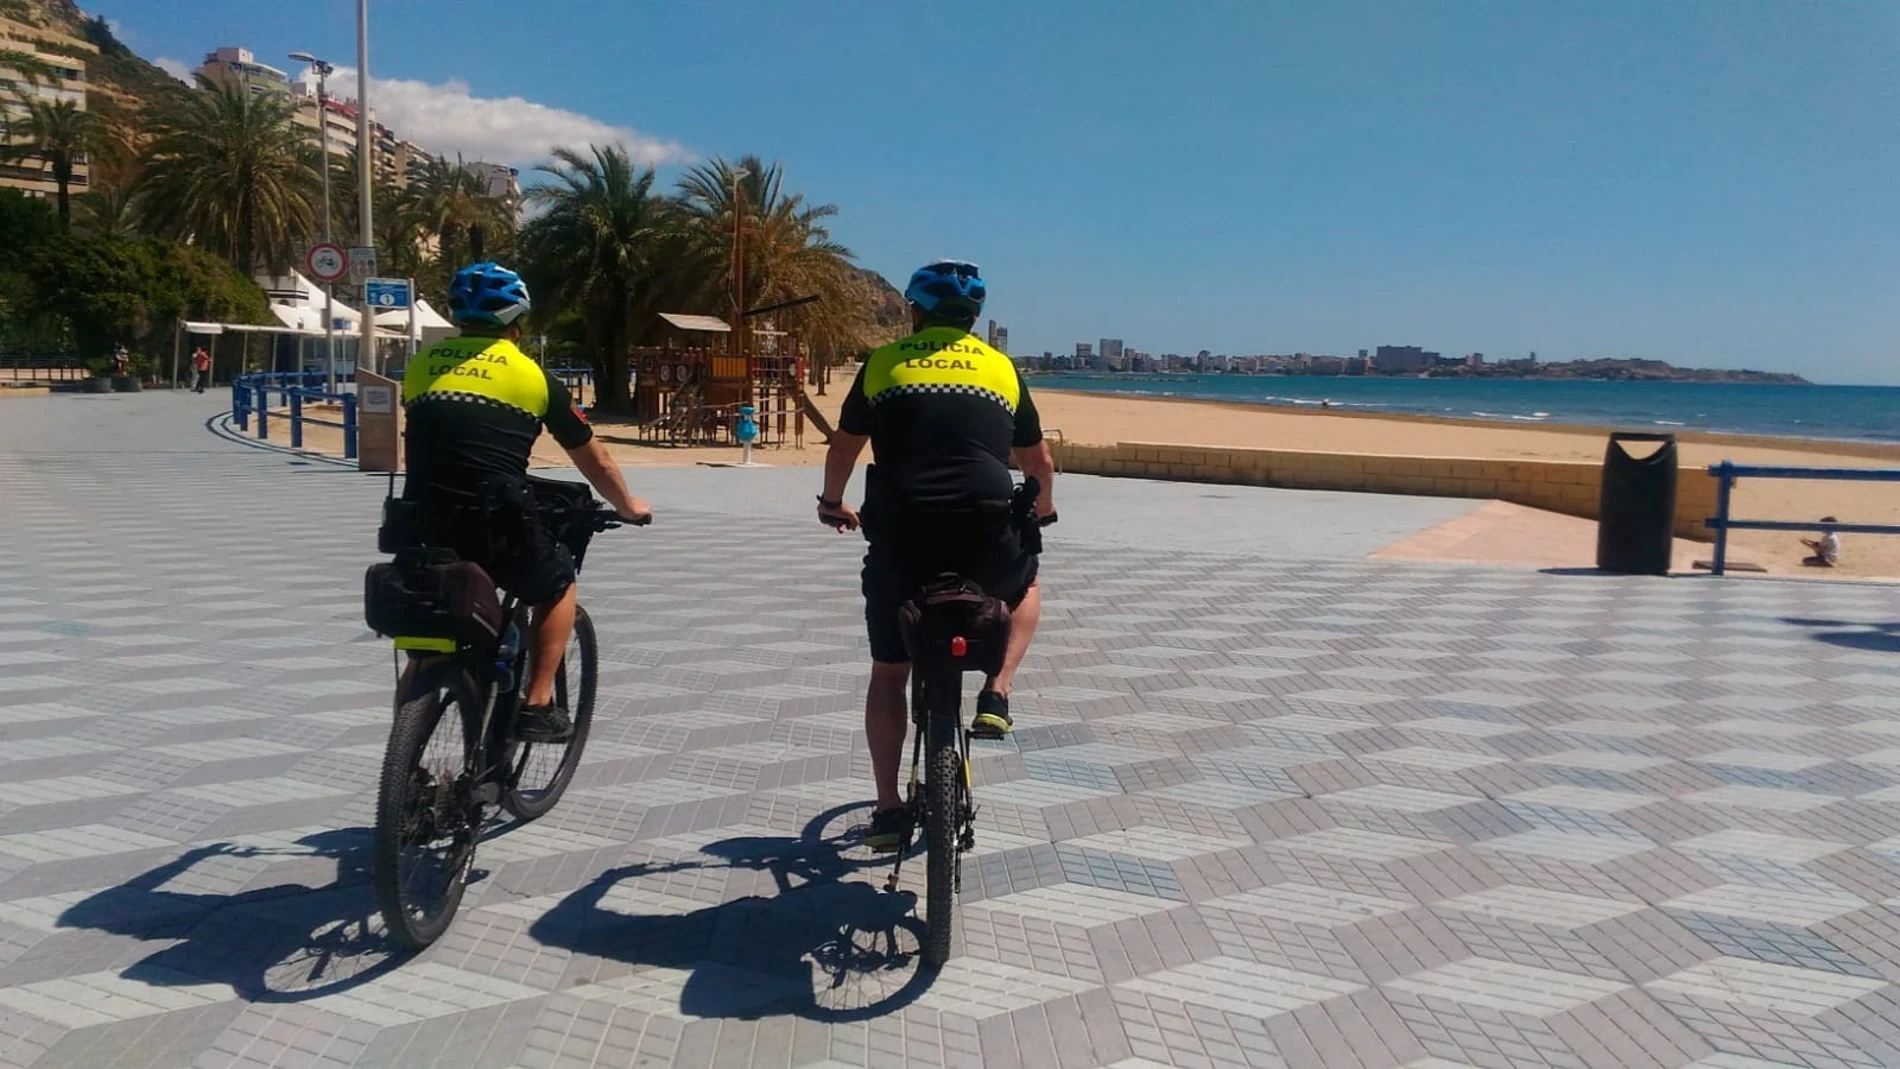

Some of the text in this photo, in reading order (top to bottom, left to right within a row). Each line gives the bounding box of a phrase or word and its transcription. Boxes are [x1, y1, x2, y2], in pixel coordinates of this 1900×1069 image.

[899, 340, 986, 356] POLICIA
[428, 348, 508, 366] POLICIA
[905, 358, 978, 371] LOCAL
[428, 364, 493, 380] LOCAL
